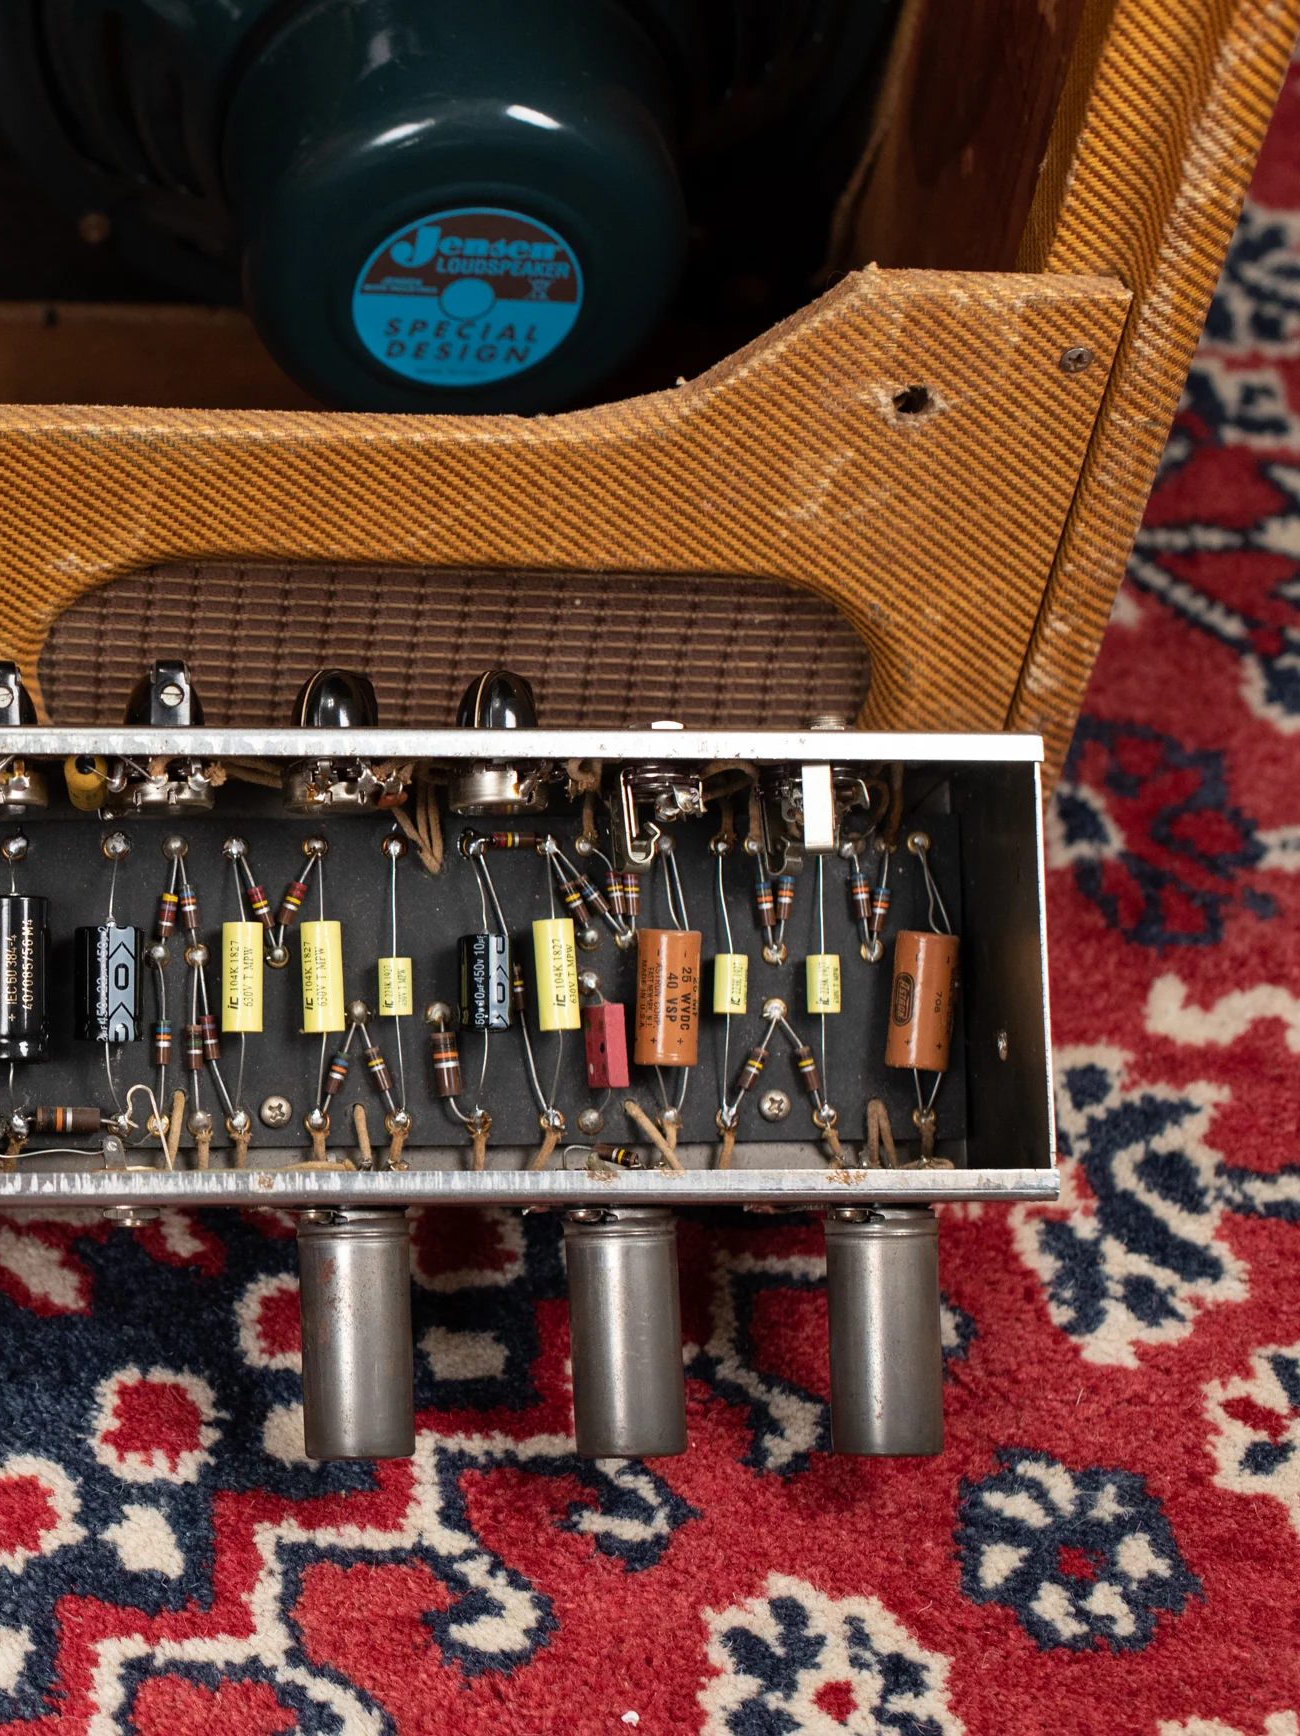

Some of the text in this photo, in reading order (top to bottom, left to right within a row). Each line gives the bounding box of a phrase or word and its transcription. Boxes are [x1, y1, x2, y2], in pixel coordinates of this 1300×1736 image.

[389, 226, 558, 268] Jensen
[436, 257, 572, 279] LOUDSPEAKER
[384, 318, 538, 343] SPECIAL
[384, 341, 531, 364] DESIGN
[230, 940, 239, 963] 1827
[303, 941, 312, 964] 1827
[552, 938, 562, 961] 1827
[566, 944, 575, 967] MPW
[230, 966, 239, 991] 104K
[305, 966, 313, 992] 104K
[553, 964, 565, 989] 104K
[6, 986, 18, 1005] IEC
[243, 984, 253, 1007] 630V
[568, 980, 577, 1004] 630V
[666, 972, 679, 1022] 40 VSP
[680, 966, 692, 1031] 25 WVDC
[934, 991, 943, 1013] 708
